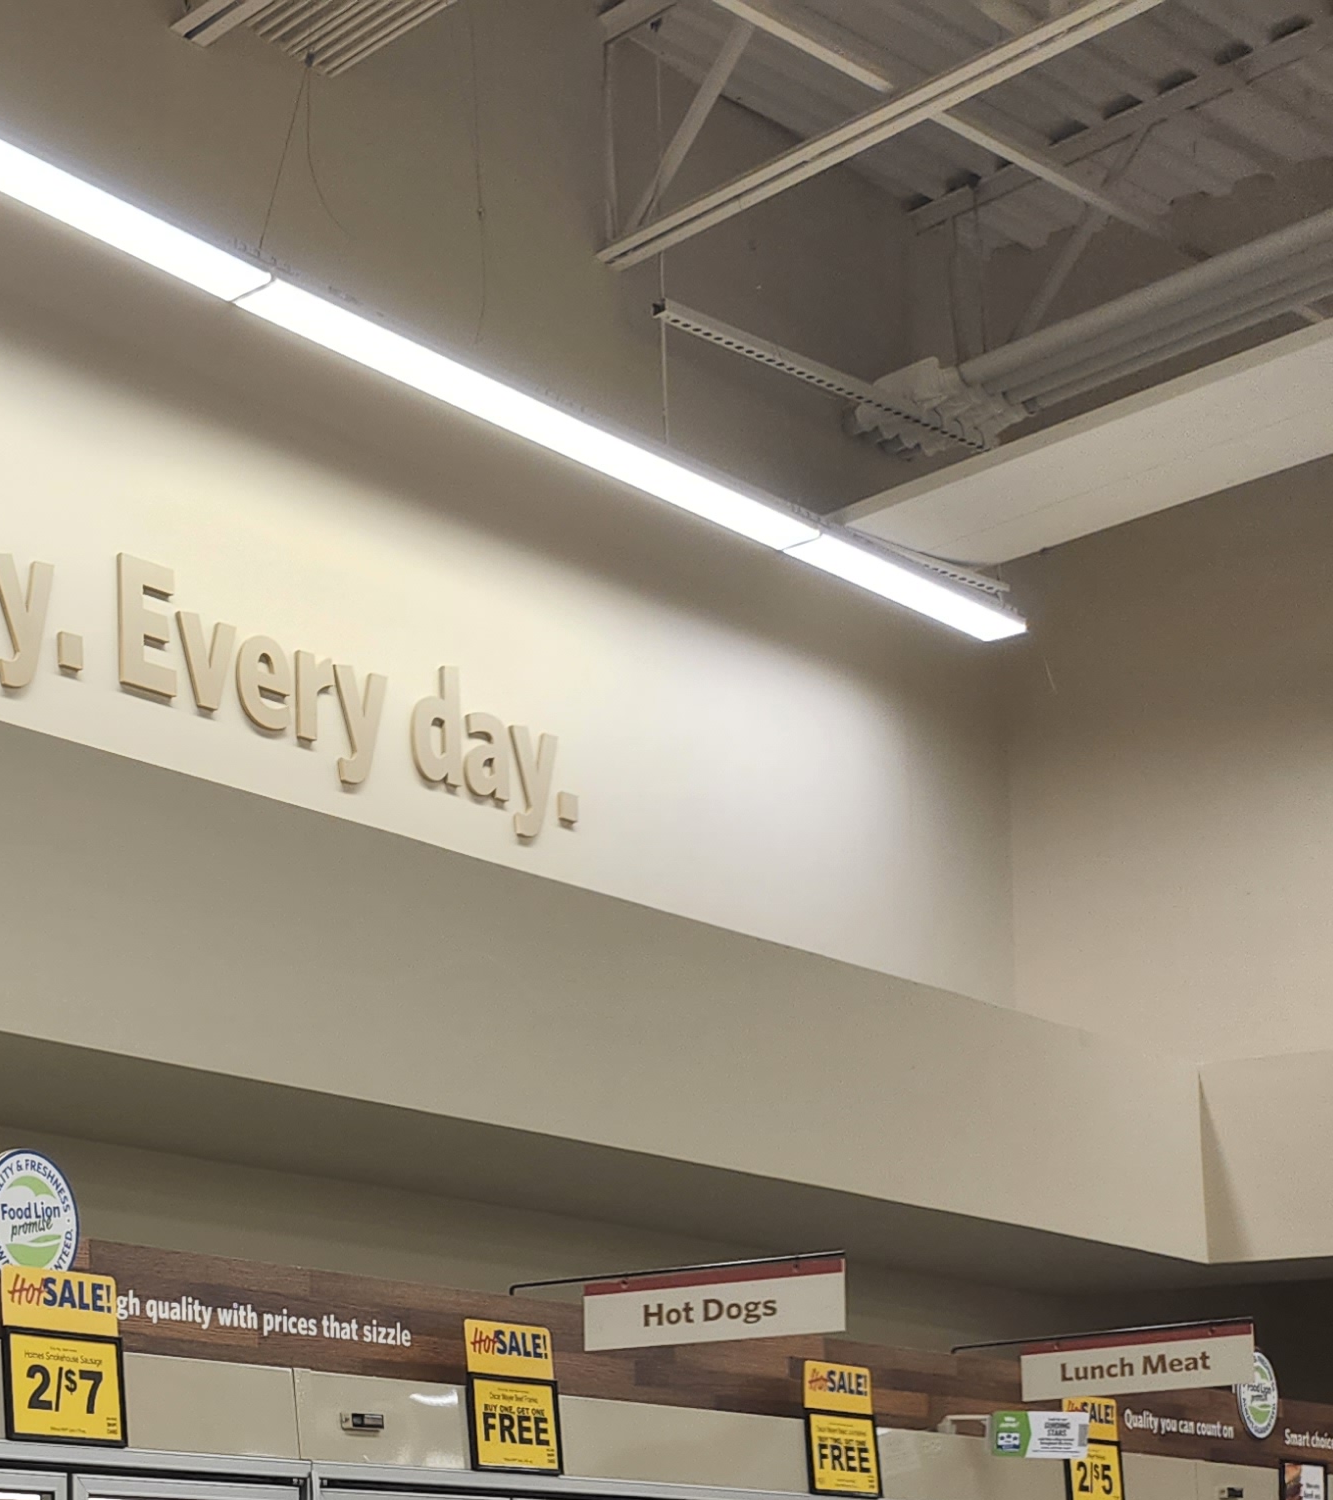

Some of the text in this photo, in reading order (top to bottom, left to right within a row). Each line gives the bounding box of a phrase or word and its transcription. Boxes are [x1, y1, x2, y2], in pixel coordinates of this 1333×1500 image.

[116, 551, 389, 786] Every
[409, 665, 580, 841] day.
[16, 1159, 23, 1171] &
[25, 1159, 71, 1213] FRESHNESS
[1, 1201, 61, 1221] Food Lion
[10, 1217, 54, 1241] promise
[116, 1290, 411, 1347] gh quality with prices that sizzle
[642, 1297, 777, 1327] Hot Dogs
[1060, 1351, 1210, 1382] Lunch Meat
[483, 1412, 550, 1446] FREE
[1124, 1408, 1234, 1439] Quality you can count on
[1285, 1428, 1309, 1447] Smart
[818, 1443, 871, 1473] FREE
